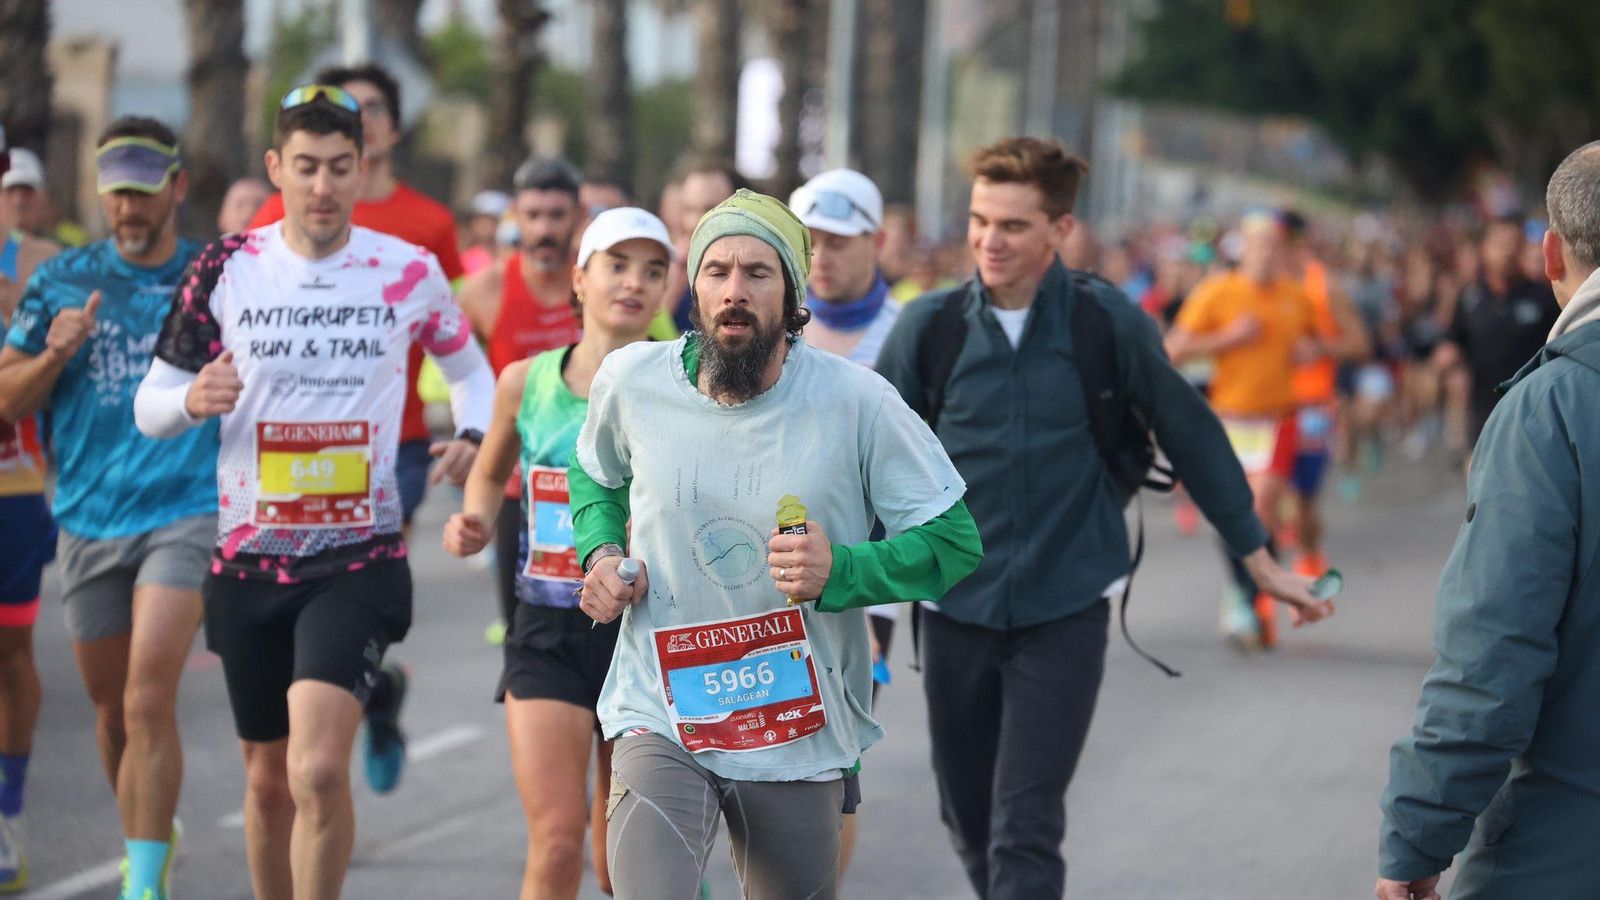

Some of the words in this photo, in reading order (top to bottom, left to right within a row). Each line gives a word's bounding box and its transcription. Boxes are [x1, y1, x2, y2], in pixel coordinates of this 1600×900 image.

[238, 306, 397, 329] ANTIGRUPETA
[250, 339, 292, 360] RUN
[300, 339, 319, 359] &
[328, 338, 386, 359] TRAIL
[291, 458, 335, 480] 649
[696, 615, 793, 649] GENERALI
[703, 661, 775, 696] 5966
[717, 691, 770, 706] SALAGEAN
[776, 709, 803, 722] 42K
